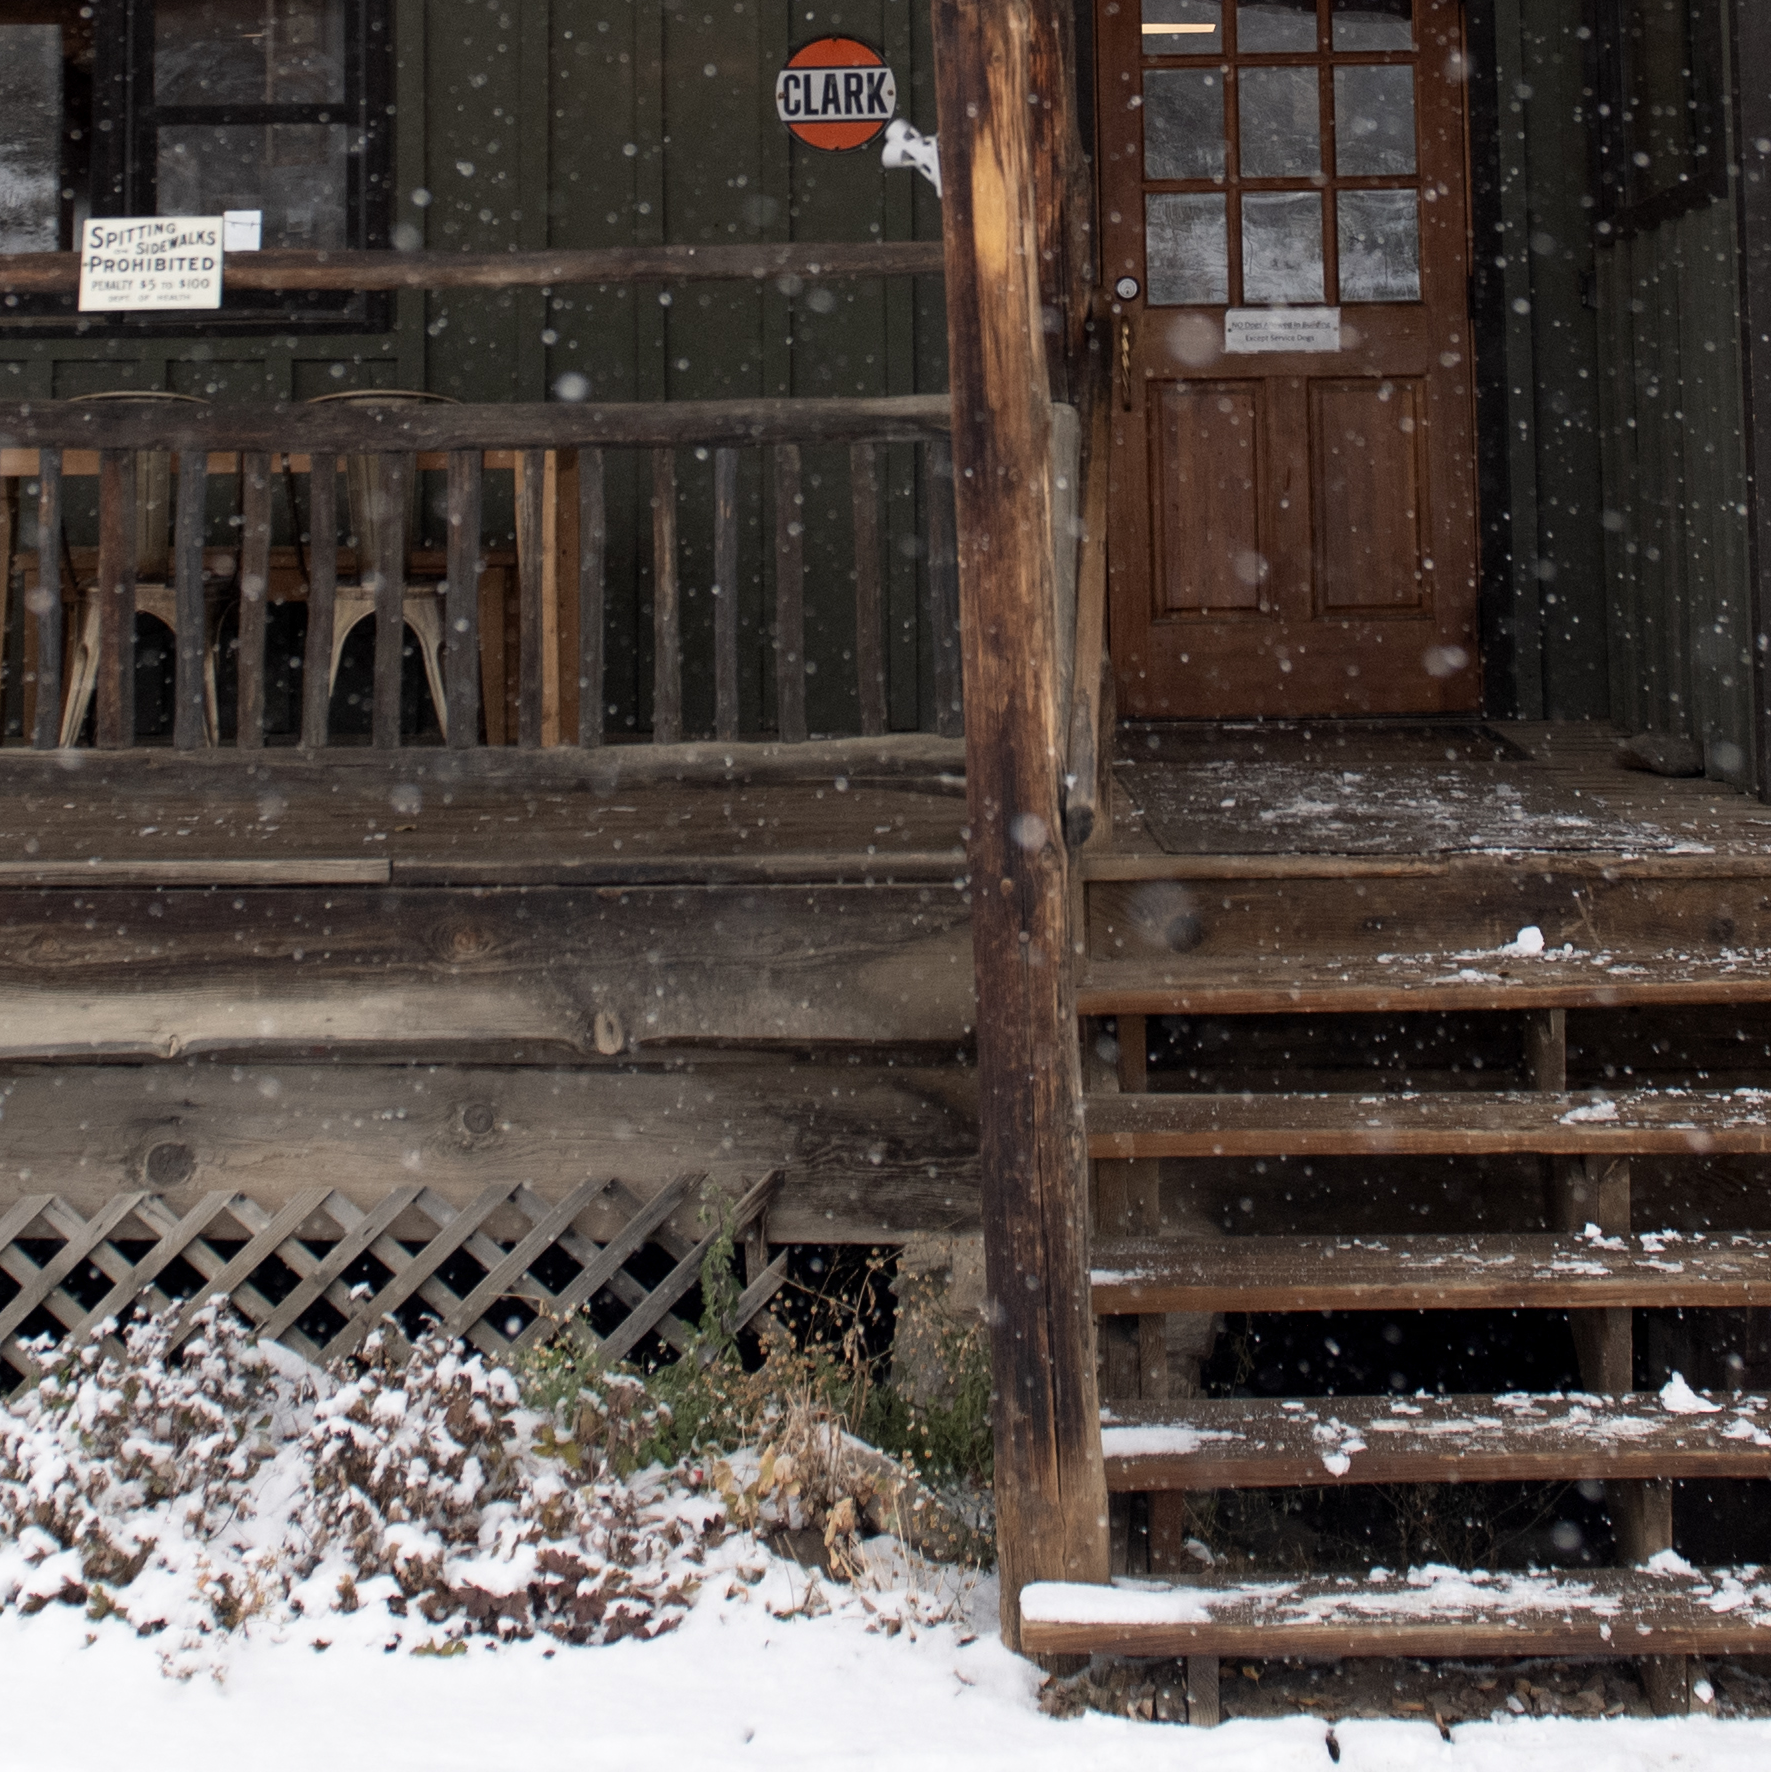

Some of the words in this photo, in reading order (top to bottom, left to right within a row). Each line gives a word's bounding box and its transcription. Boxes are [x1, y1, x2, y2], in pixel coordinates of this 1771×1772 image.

[782, 71, 888, 116] CLARK
[89, 222, 176, 249] SPITTING
[135, 231, 216, 255] SIDEWALKS
[89, 256, 215, 273] PROHIBITED
[91, 279, 133, 291] PENALTY
[140, 278, 156, 291] $5
[179, 278, 210, 290] $100
[1262, 321, 1293, 329] Awed
[1245, 334, 1269, 343] Except
[1296, 334, 1315, 343] Dogs
